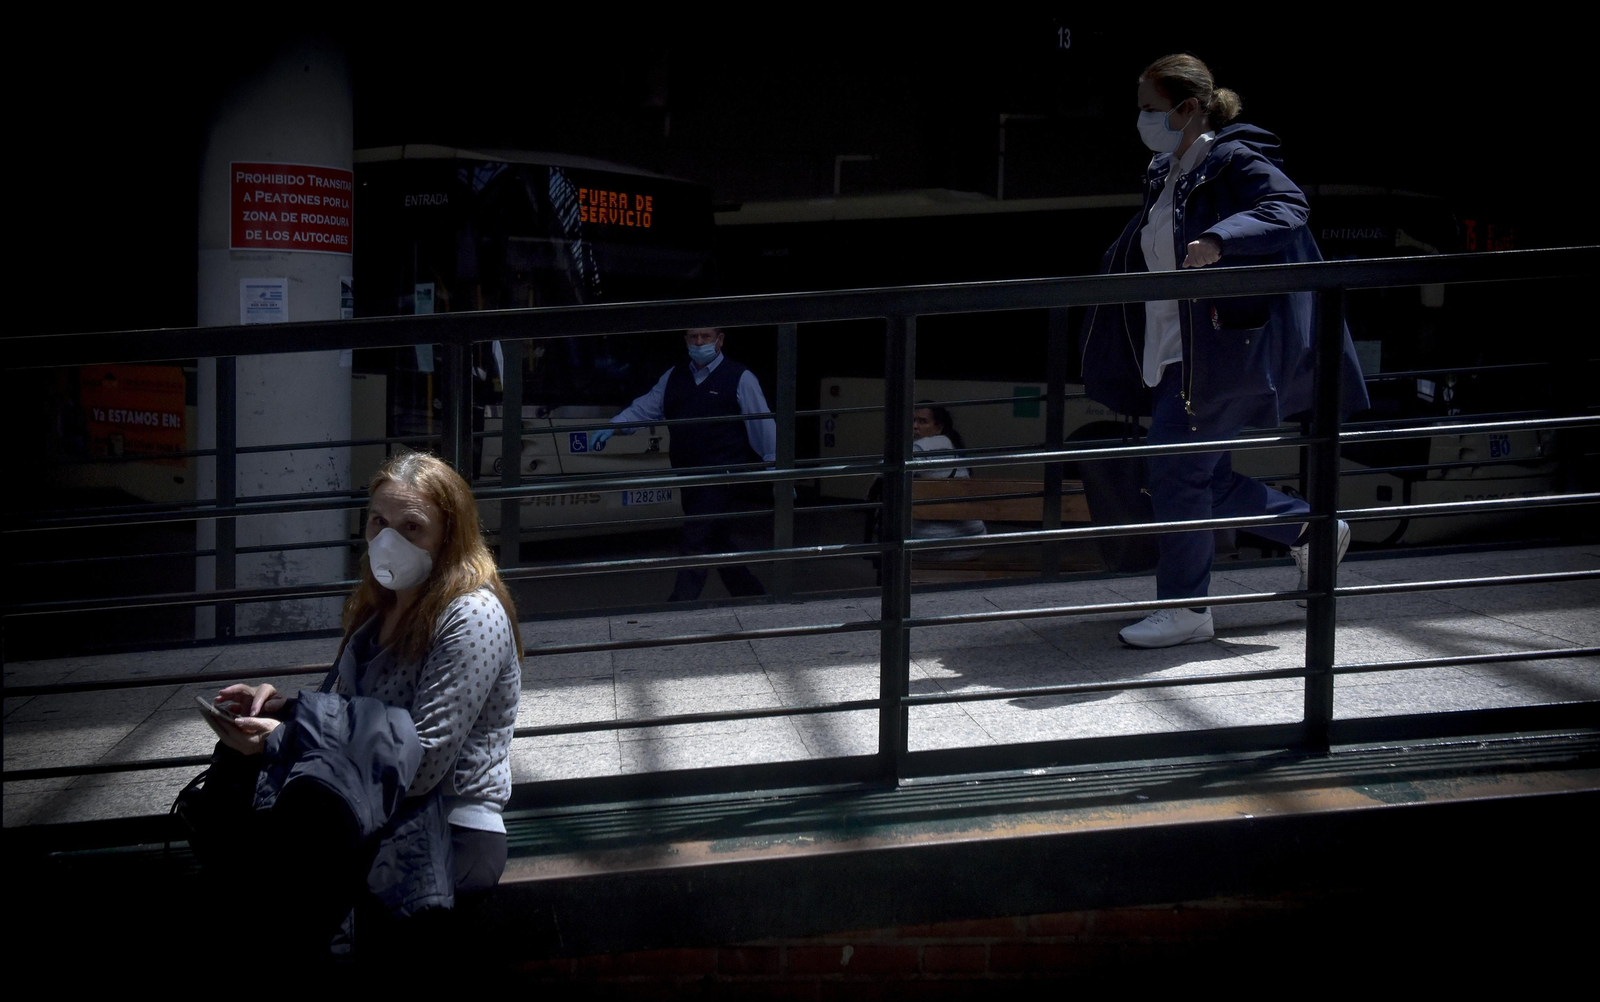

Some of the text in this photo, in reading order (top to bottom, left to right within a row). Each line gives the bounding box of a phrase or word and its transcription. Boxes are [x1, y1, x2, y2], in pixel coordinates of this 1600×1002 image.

[1057, 26, 1071, 49] 13
[236, 171, 352, 191] PROHIBIDO TRANSITAR
[243, 190, 350, 209] A PEATONES POR LA
[404, 193, 449, 207] ENTRADA
[578, 187, 654, 212] FUERA DE
[243, 211, 350, 227] ZONA DE RODADURA
[580, 205, 652, 229] SERVICIO
[245, 230, 349, 245] DE LOS AUTOCARES
[1321, 226, 1383, 240] ENTRADA
[93, 408, 181, 428] Ya ESTAMOS EN:
[630, 490, 654, 503] 1282
